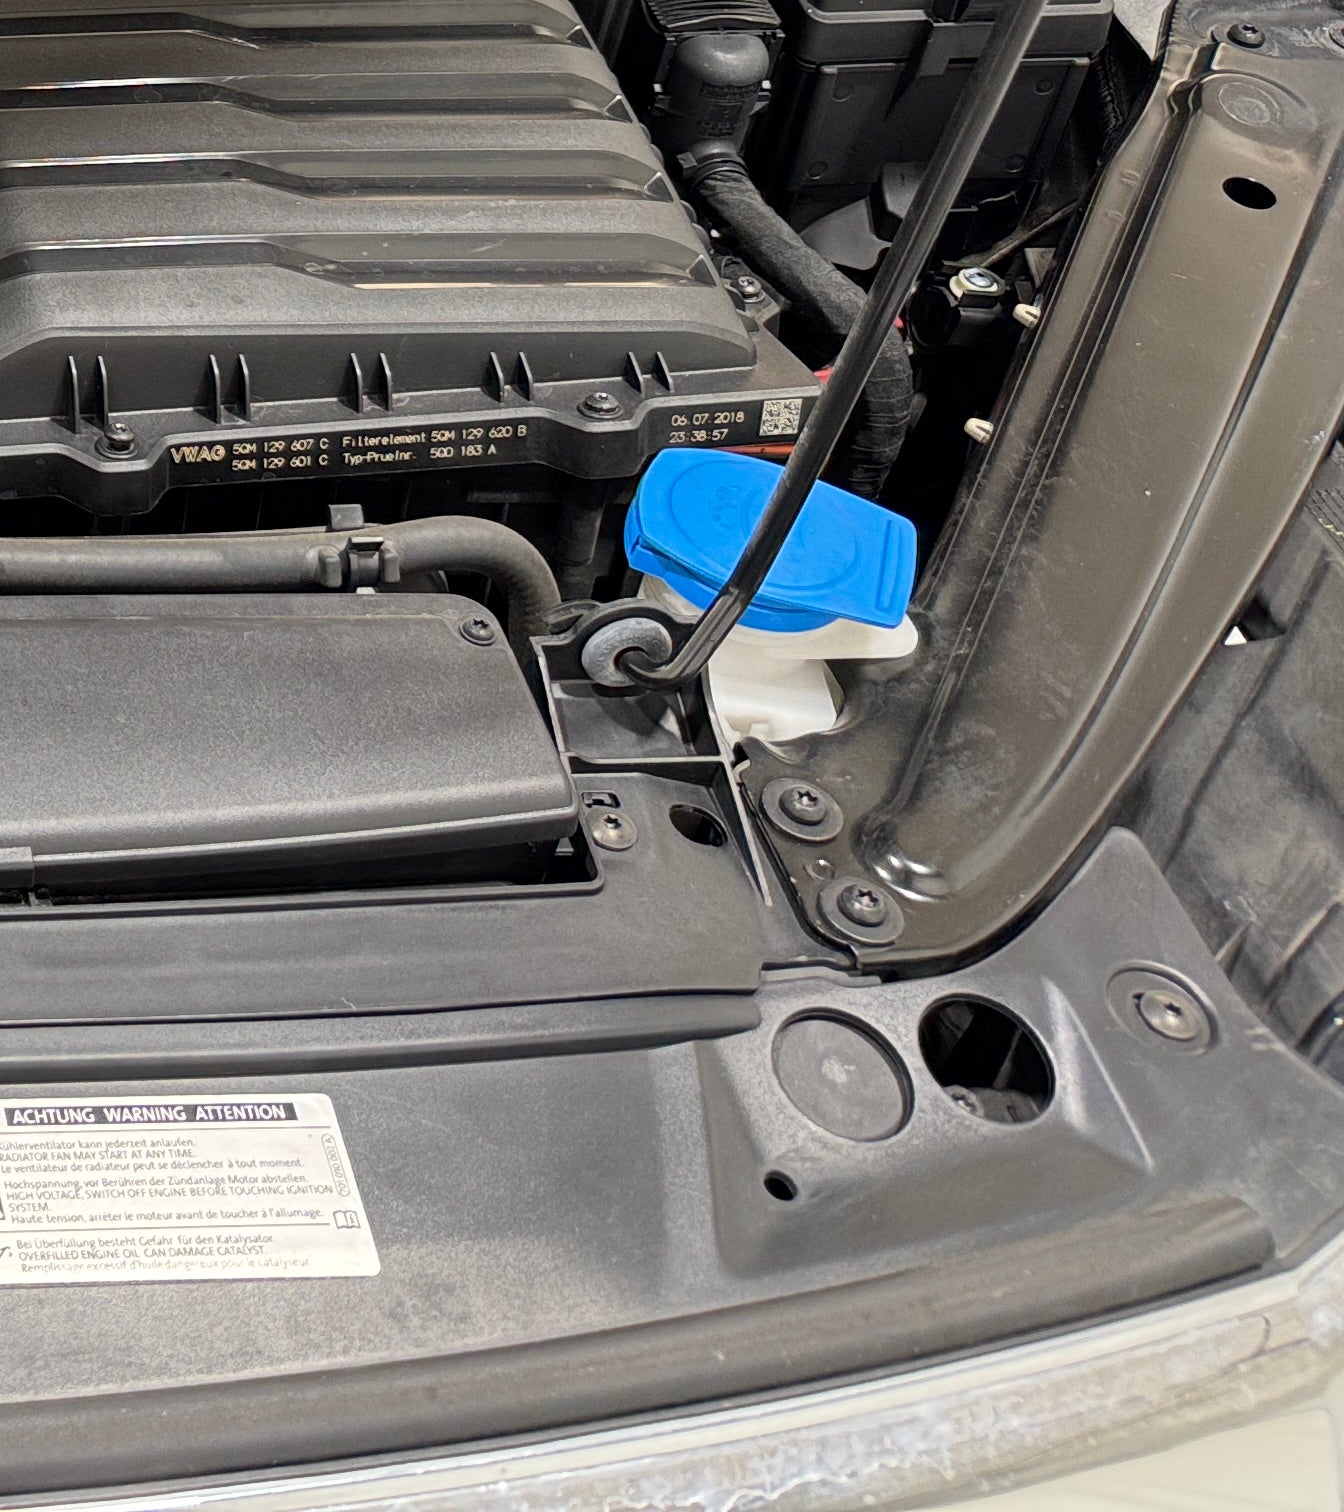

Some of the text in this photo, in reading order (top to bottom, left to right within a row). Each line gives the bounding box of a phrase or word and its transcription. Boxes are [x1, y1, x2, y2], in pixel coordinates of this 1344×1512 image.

[232, 424, 528, 455] 5QM 129 607 C Filterelement 5QM 129 620 B
[669, 429, 729, 444] 23:38:57
[170, 444, 226, 464] VWAG
[231, 459, 256, 471] 5QM
[263, 457, 286, 469] 129
[289, 455, 312, 468] 601
[318, 454, 329, 466] C
[460, 444, 483, 457] 183
[487, 444, 497, 456] A
[12, 1104, 286, 1124] ACHTUNG WARNING ATTENTION
[78, 1139, 103, 1149] kann
[104, 1138, 148, 1151] jederzeit
[51, 1150, 72, 1161] FAN
[73, 1150, 96, 1160] MAY
[98, 1150, 128, 1160] START
[131, 1150, 143, 1160] AT
[146, 1149, 166, 1159] ANY
[0, 1164, 12, 1174] Le
[14, 1162, 68, 1174] ventilateur
[70, 1162, 83, 1172] de
[85, 1161, 130, 1172] radiateur
[133, 1161, 156, 1172] peut
[158, 1161, 169, 1170] se
[171, 1158, 224, 1170] déclencher
[227, 1158, 234, 1168] à
[236, 1159, 257, 1168] tout
[83, 1180, 99, 1188] vor
[102, 1176, 148, 1188] Berühren
[149, 1176, 165, 1186] der
[168, 1174, 226, 1188] Zündanlage
[228, 1174, 259, 1184] Motor
[7, 1184, 334, 1200] HIGH SWITCH OFF ENGINE BEFORE TOUCHING IGNITION
[11, 1214, 43, 1224] Haute
[124, 1212, 134, 1222] le
[136, 1211, 173, 1222] moteur
[176, 1210, 204, 1220] avant
[206, 1210, 218, 1220] de
[220, 1209, 258, 1219] toucher
[16, 1239, 32, 1250] Bei
[98, 1237, 136, 1247] besteht
[139, 1236, 173, 1246] Gefahr
[178, 1234, 192, 1245] für
[196, 1234, 214, 1244] den
[18, 1246, 214, 1261] OVERFILLED ENGINE OIL CAN DAMAGE
